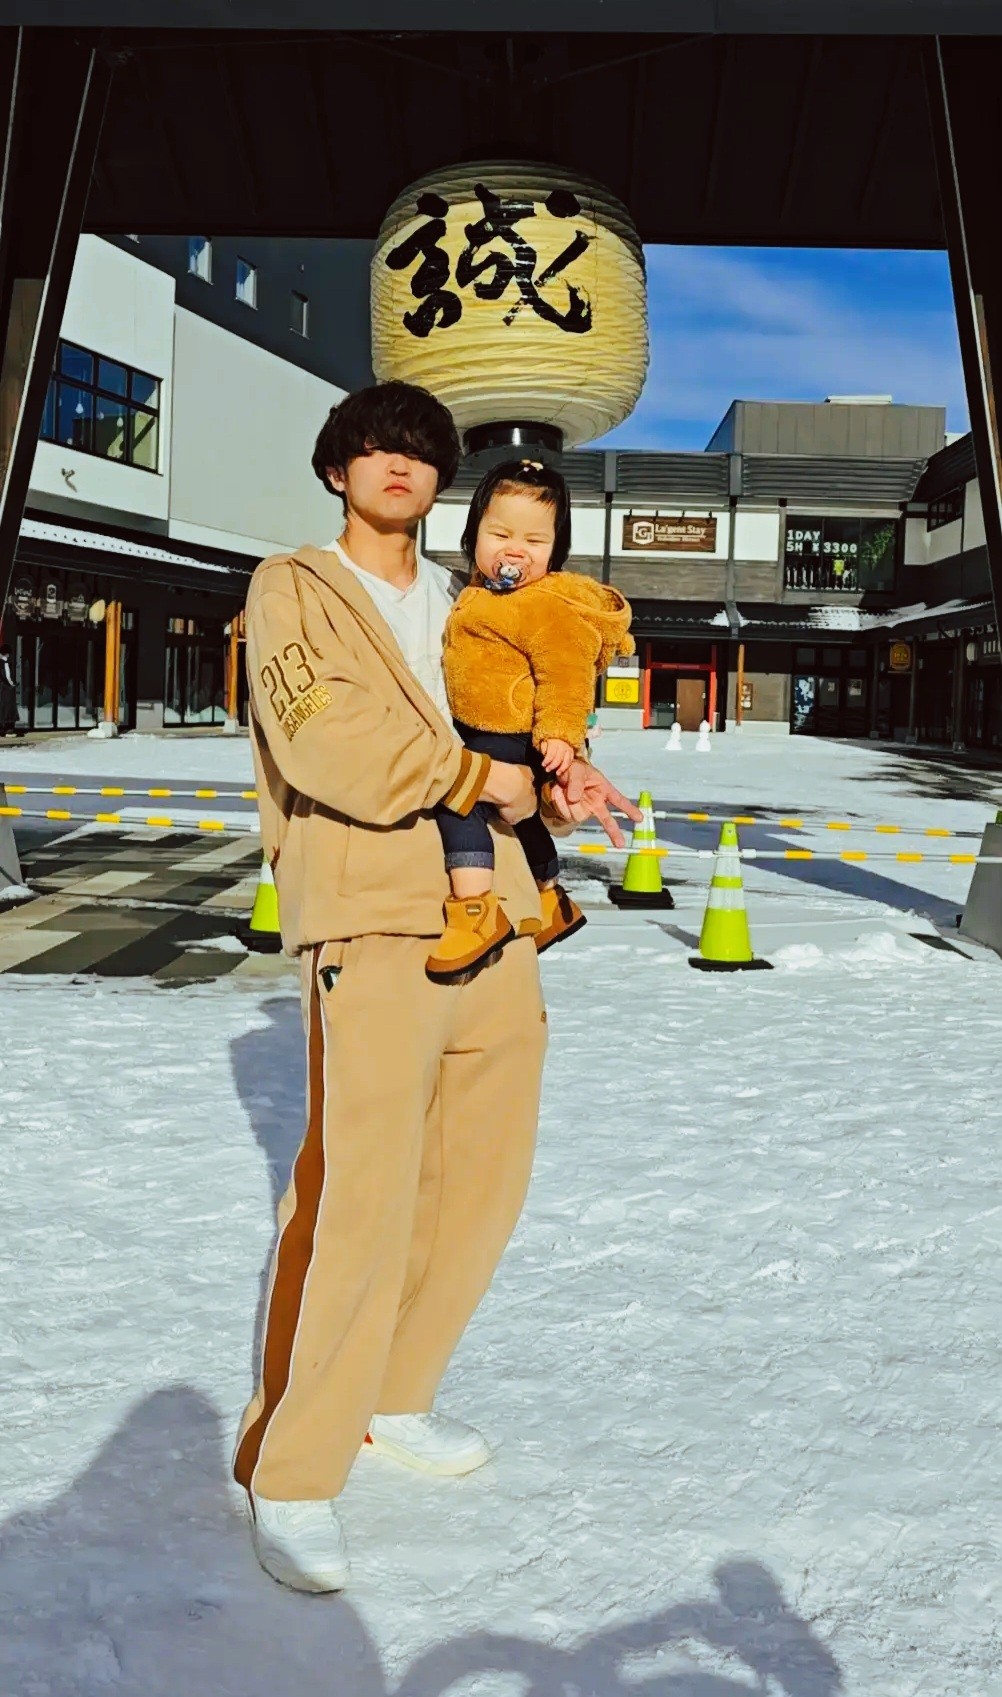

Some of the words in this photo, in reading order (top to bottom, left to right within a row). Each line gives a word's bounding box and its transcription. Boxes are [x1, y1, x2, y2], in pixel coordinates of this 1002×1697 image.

[385, 183, 597, 337] 誠
[687, 525, 706, 537] Stay
[787, 529, 820, 541] 1DAY
[786, 541, 803, 552] 5H
[260, 642, 316, 722] 213
